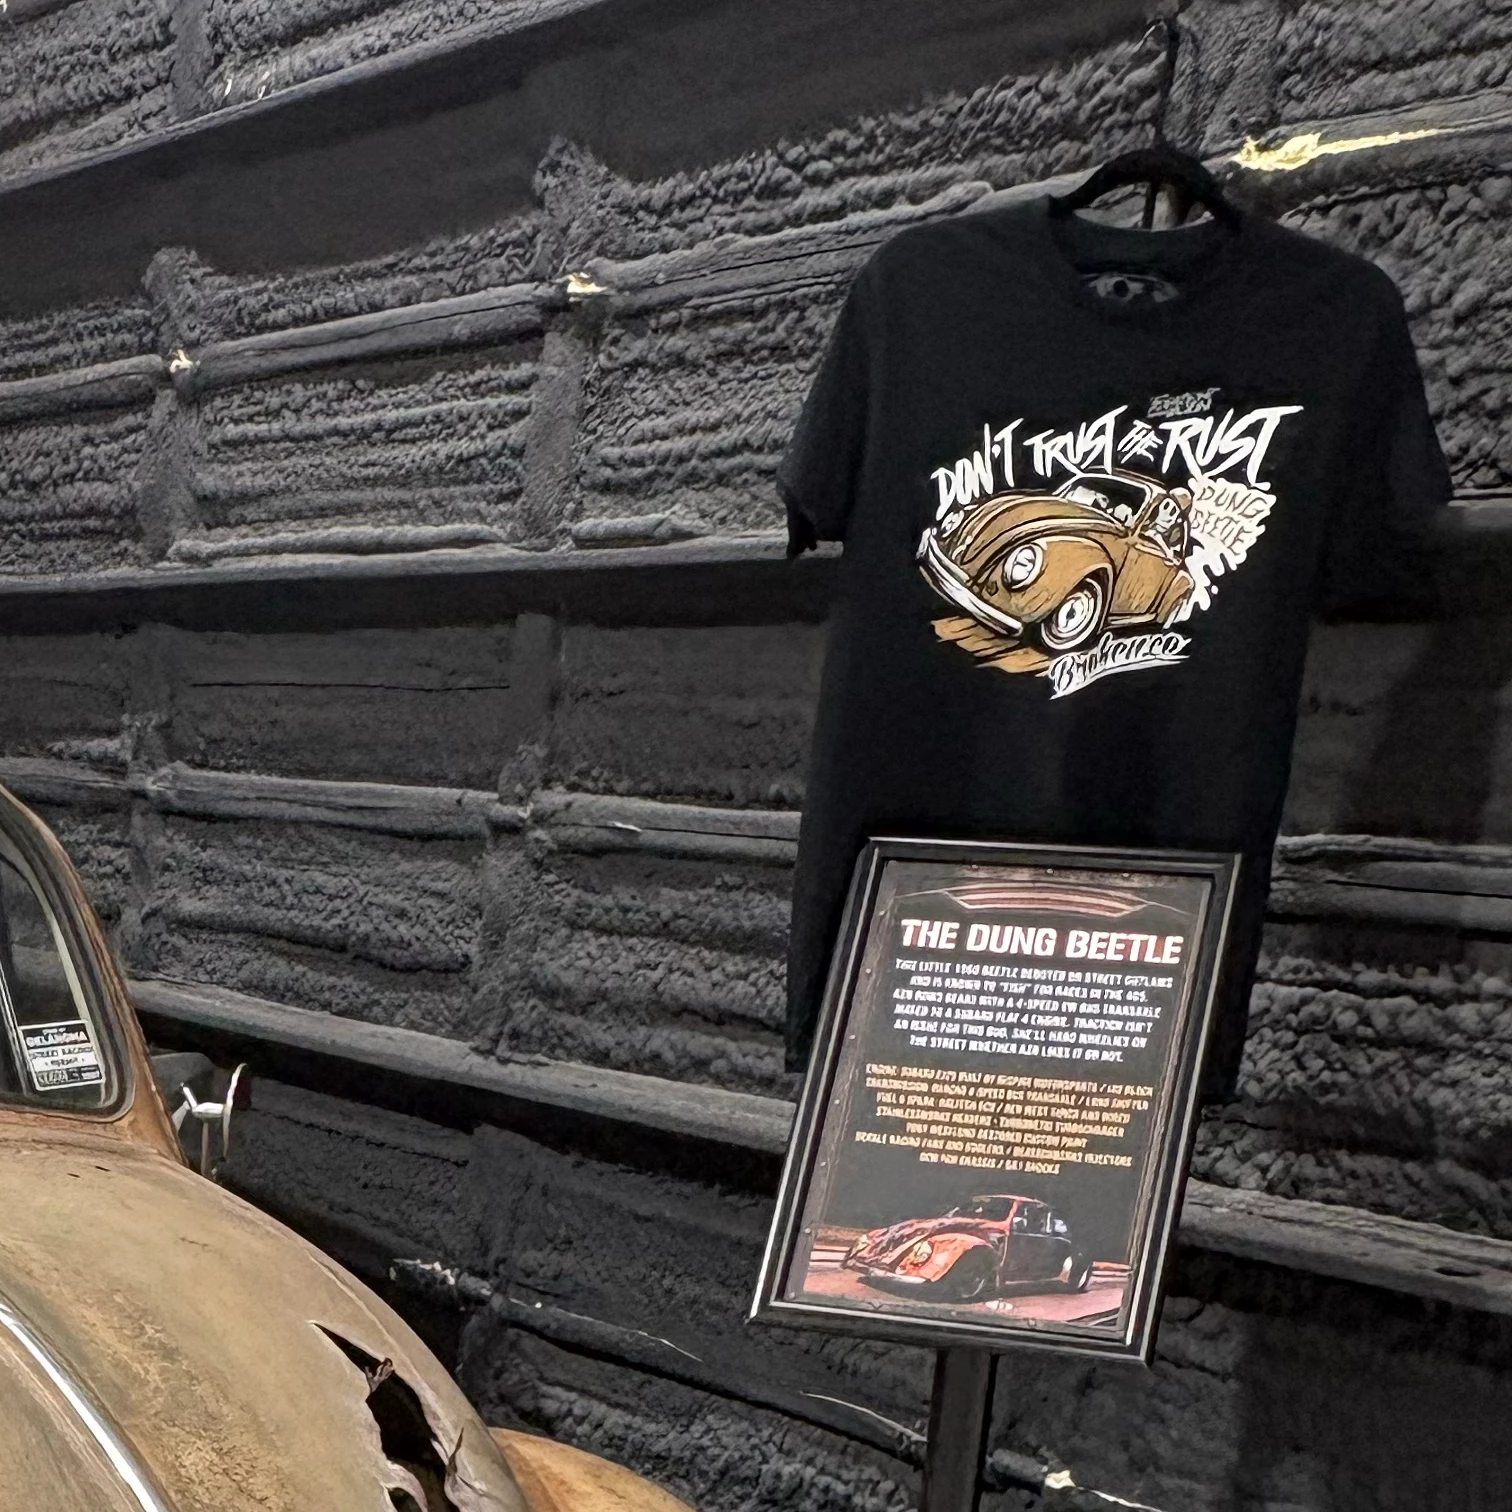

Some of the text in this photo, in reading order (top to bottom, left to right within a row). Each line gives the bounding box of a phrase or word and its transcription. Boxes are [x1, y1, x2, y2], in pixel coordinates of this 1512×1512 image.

[929, 418, 1024, 521] DON'T
[1023, 405, 1129, 478] TRUST
[1159, 405, 1305, 491] RUST
[1196, 486, 1269, 518] DUNG
[901, 919, 1185, 965] THE DUNG BEETLE
